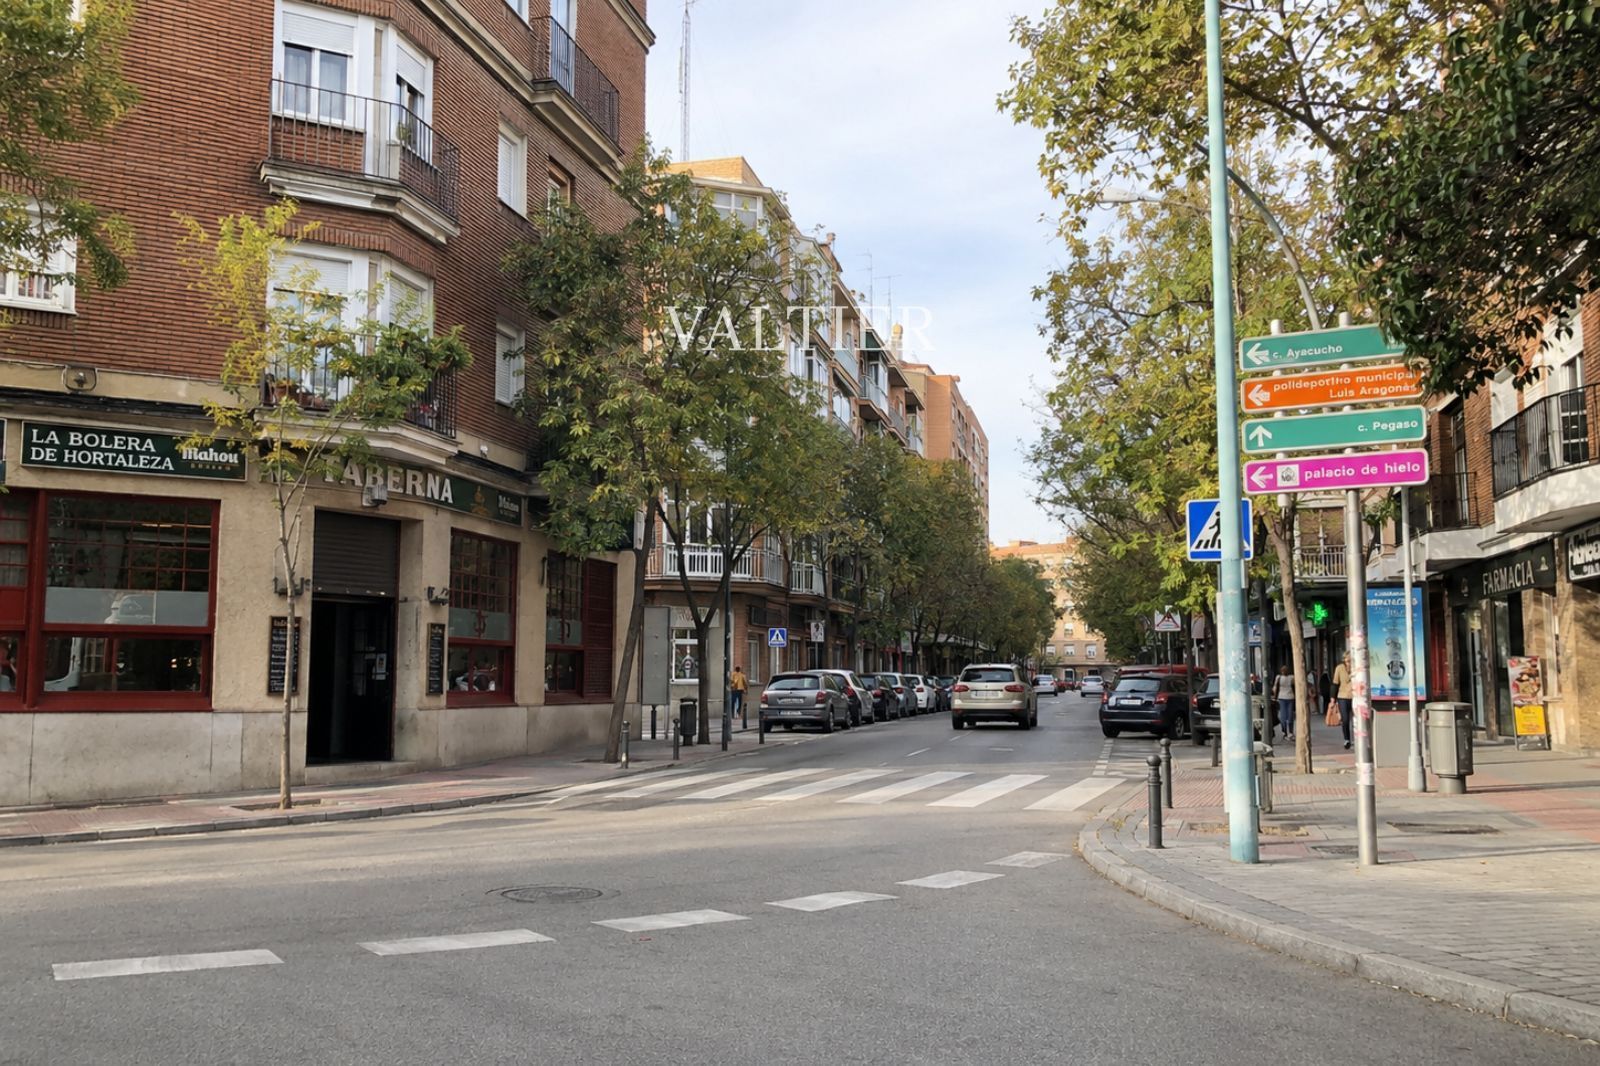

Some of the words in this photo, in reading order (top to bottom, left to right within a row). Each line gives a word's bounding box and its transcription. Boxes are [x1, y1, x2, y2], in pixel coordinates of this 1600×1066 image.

[1286, 344, 1343, 360] Ayacucho
[1329, 387, 1355, 398] Luis
[1357, 424, 1368, 432] c.
[1372, 419, 1418, 431] Pegaso
[31, 428, 60, 445] LA
[68, 431, 156, 452] BOLERA
[30, 447, 57, 462] DE
[63, 449, 174, 471] HORTALEZA
[182, 447, 239, 463] Mahou
[1304, 466, 1355, 481] palacio
[1361, 464, 1378, 474] de
[1385, 461, 1420, 473] hielo
[1482, 560, 1535, 595] FARMACIA
